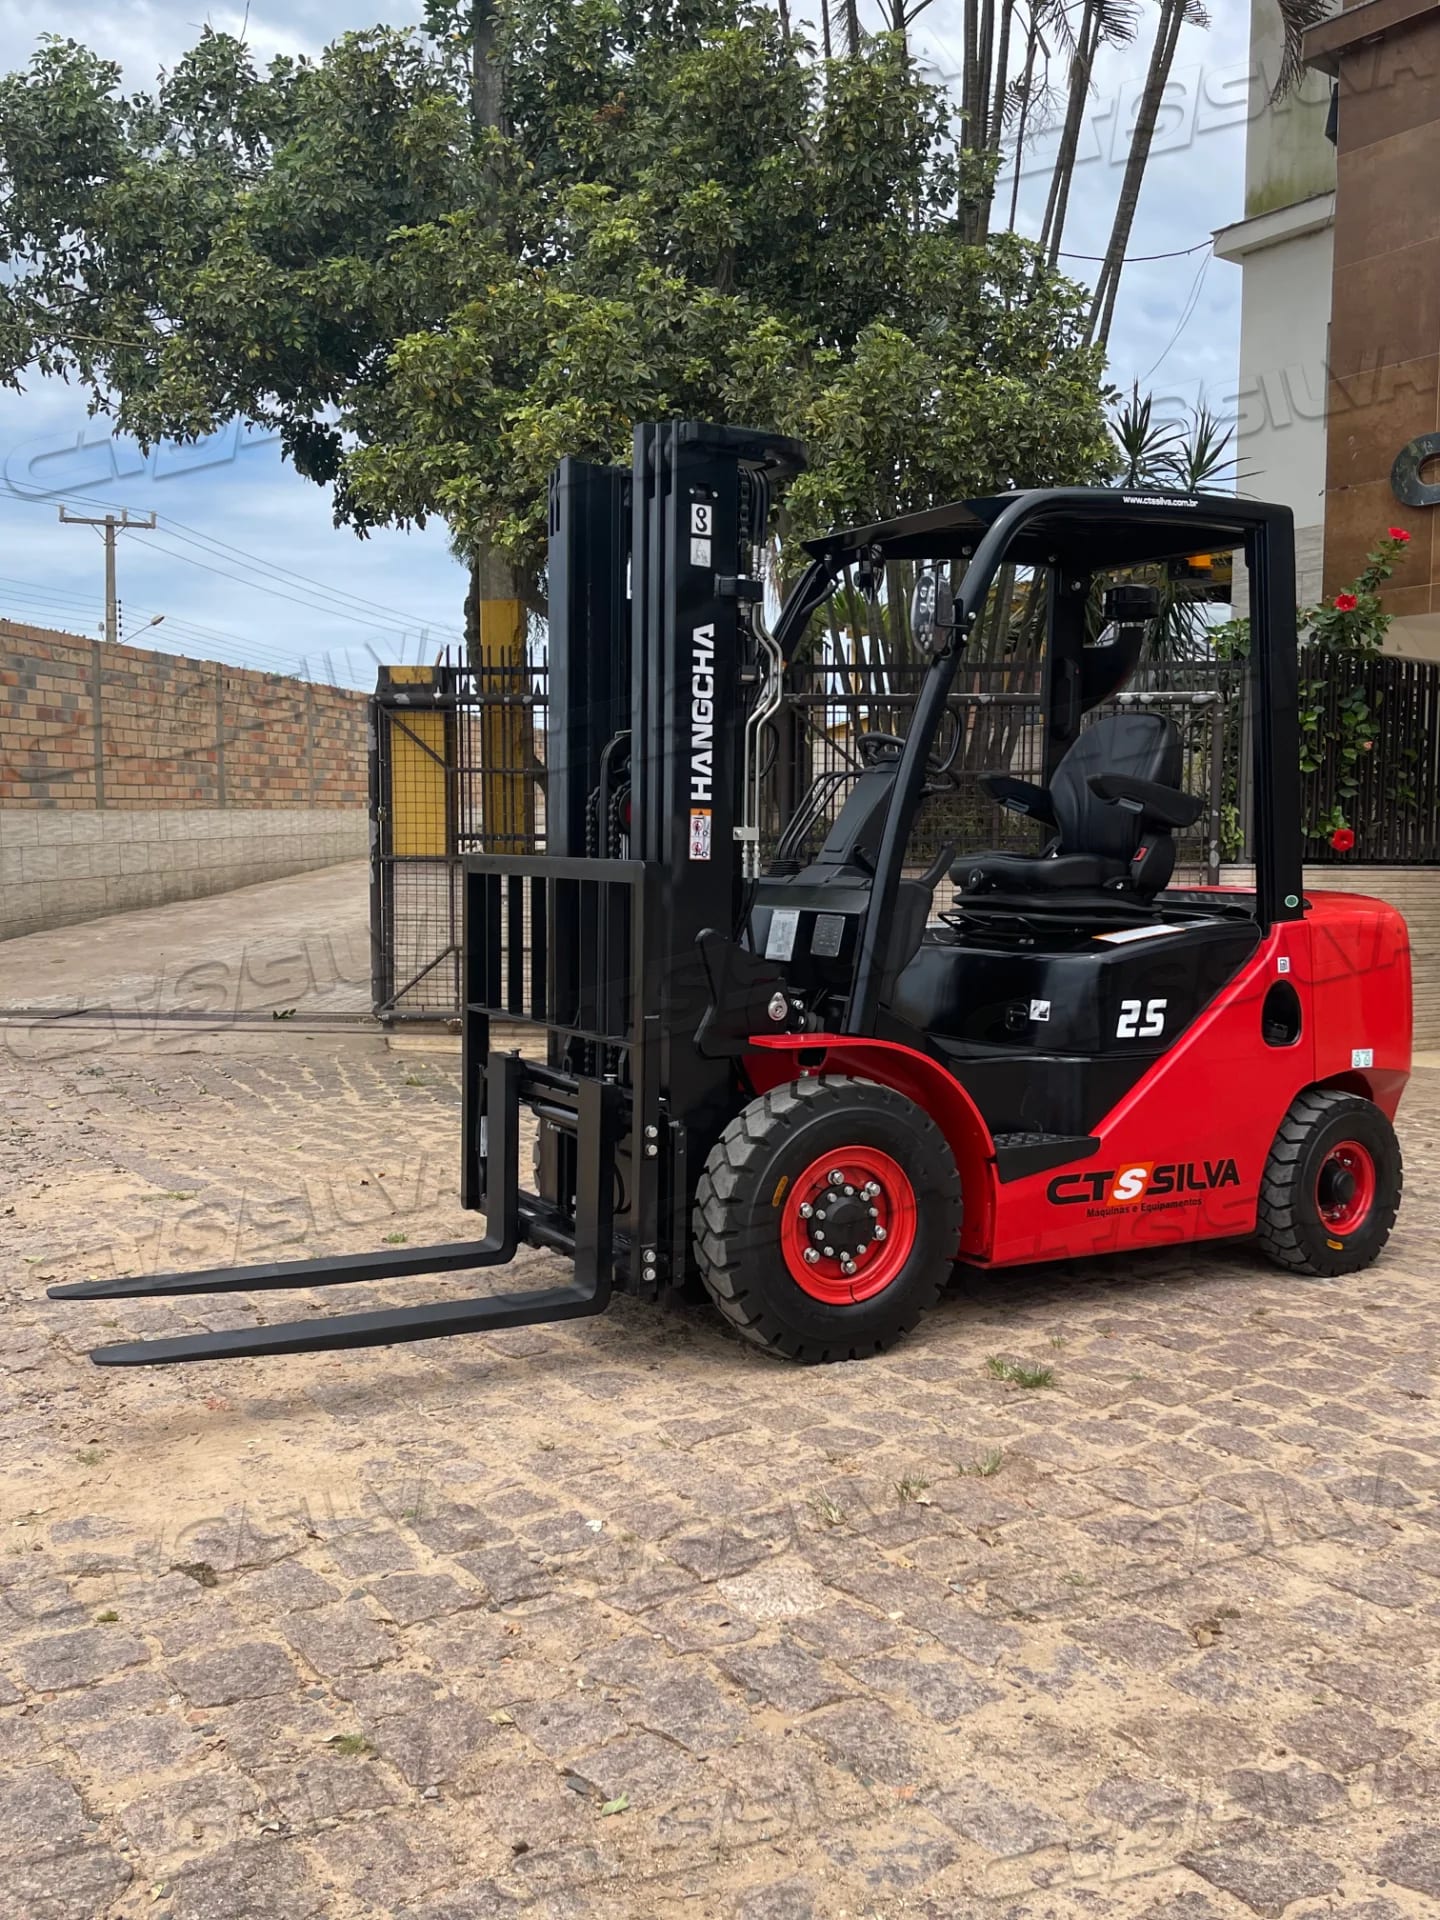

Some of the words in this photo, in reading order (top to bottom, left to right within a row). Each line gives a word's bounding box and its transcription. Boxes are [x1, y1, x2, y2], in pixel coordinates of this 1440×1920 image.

[1122, 496, 1199, 508] www.ctssilva.com.br
[690, 623, 716, 802] HANGCHA
[1116, 999, 1167, 1038] 25
[1140, 1198, 1203, 1212] Equipamentos
